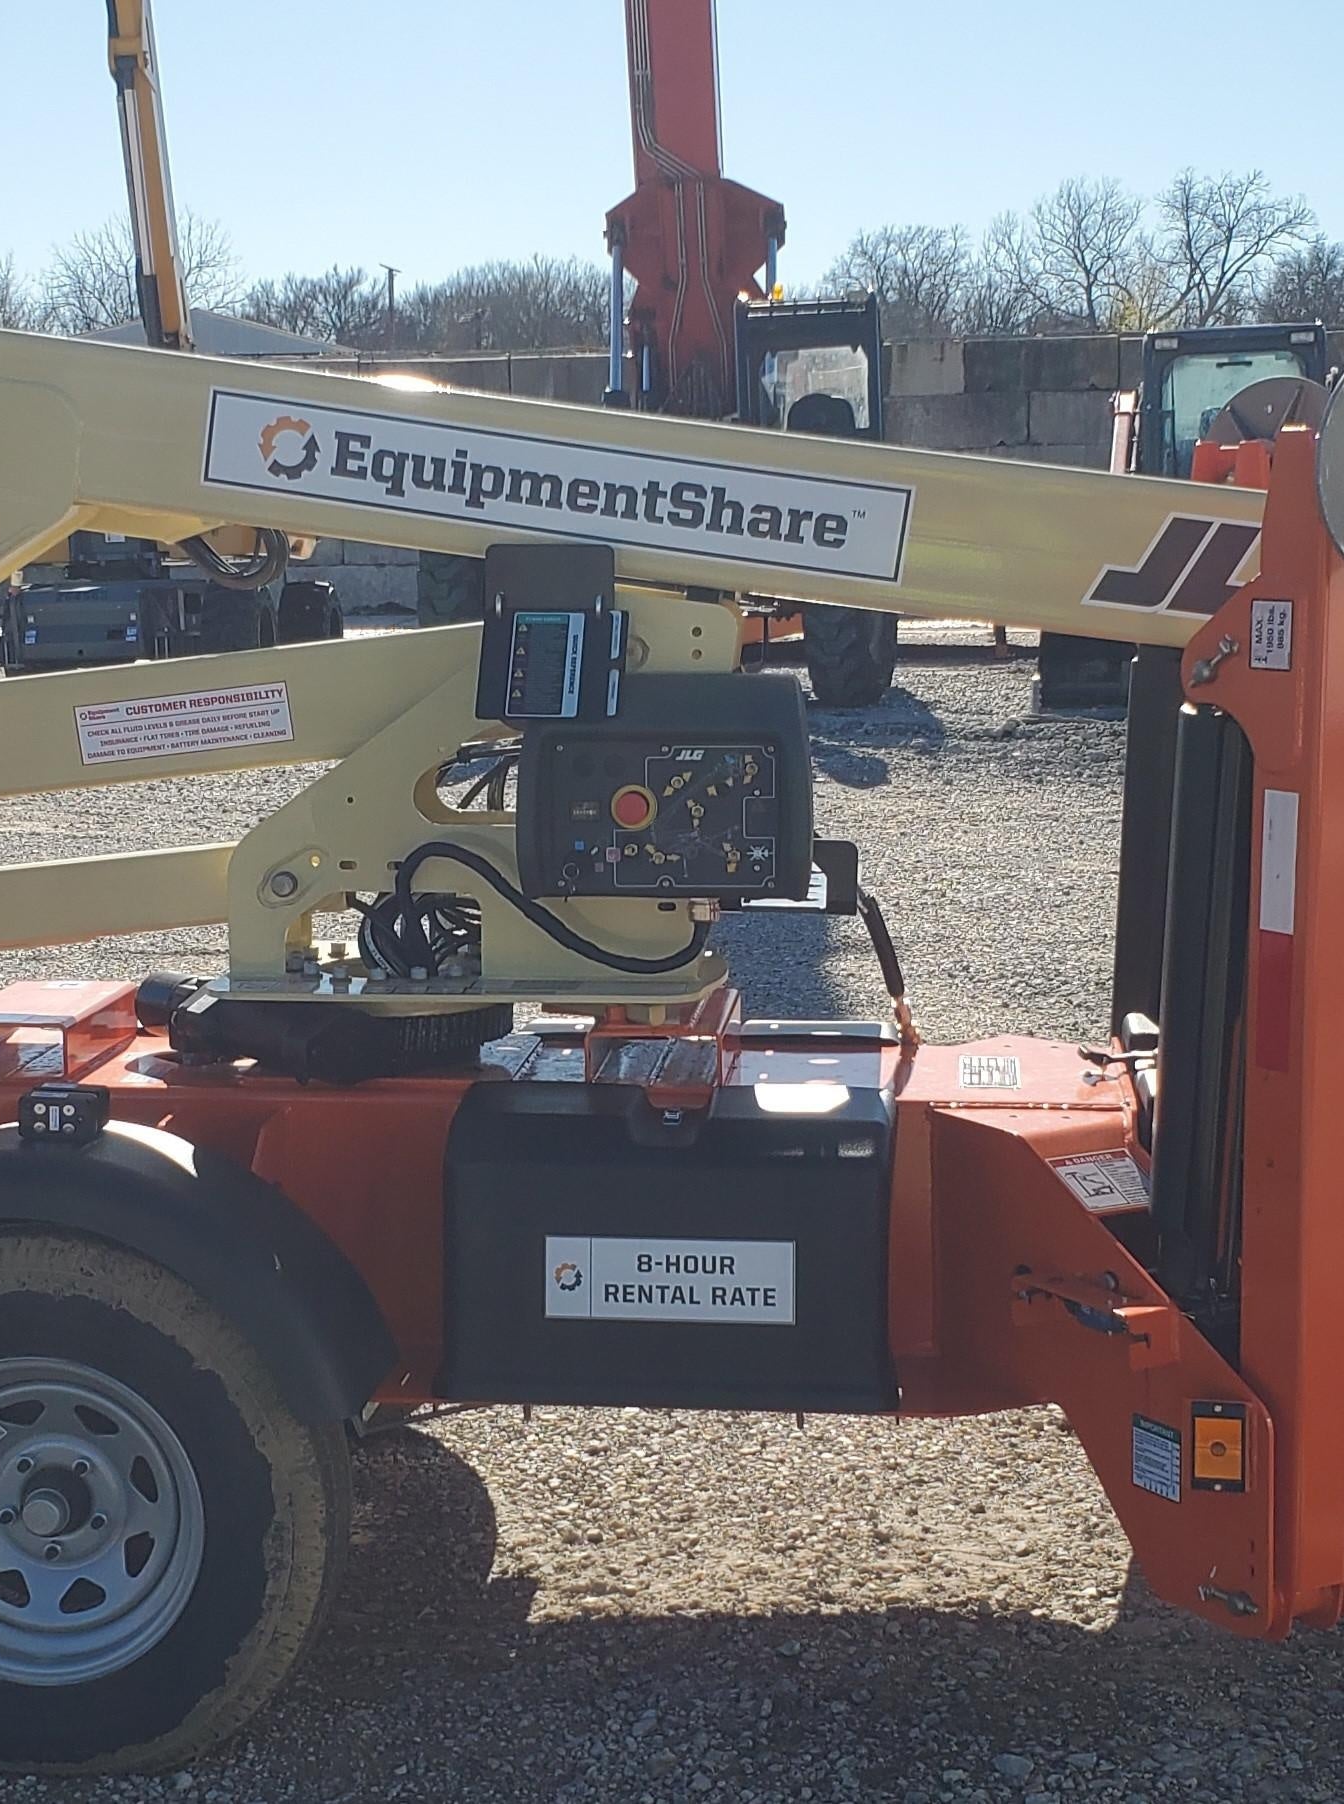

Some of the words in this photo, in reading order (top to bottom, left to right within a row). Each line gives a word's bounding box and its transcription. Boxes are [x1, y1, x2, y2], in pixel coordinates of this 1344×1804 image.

[125, 700, 187, 716] CUSTOMER
[189, 688, 284, 709] RESPONSIBILITY
[88, 729, 109, 738] CHECK
[111, 727, 122, 735] ALL
[123, 725, 143, 734] FLUID
[144, 721, 168, 731] LEVELS
[175, 718, 201, 727] GREASE
[202, 715, 221, 724] DAILY
[222, 712, 248, 721] BEFORE
[248, 709, 270, 718] START
[100, 736, 139, 746] INSURANCE
[143, 733, 159, 742] FLAT
[159, 731, 180, 740] TIRES
[184, 729, 200, 737] TIRE
[201, 725, 229, 735] DAMAGE
[234, 720, 271, 731] REFUELING
[88, 749, 116, 759] DAMAGE
[126, 744, 166, 754] EQUIPMENT
[170, 739, 200, 749] BATTERY
[201, 734, 249, 746] MAINTENANCE
[253, 729, 287, 739] CLEANING
[675, 750, 705, 761] JLG
[1072, 1153, 1113, 1164] DANGER
[636, 1253, 735, 1275] 8-HOUR
[604, 1283, 701, 1305] RENTAL
[711, 1286, 777, 1307] RATE
